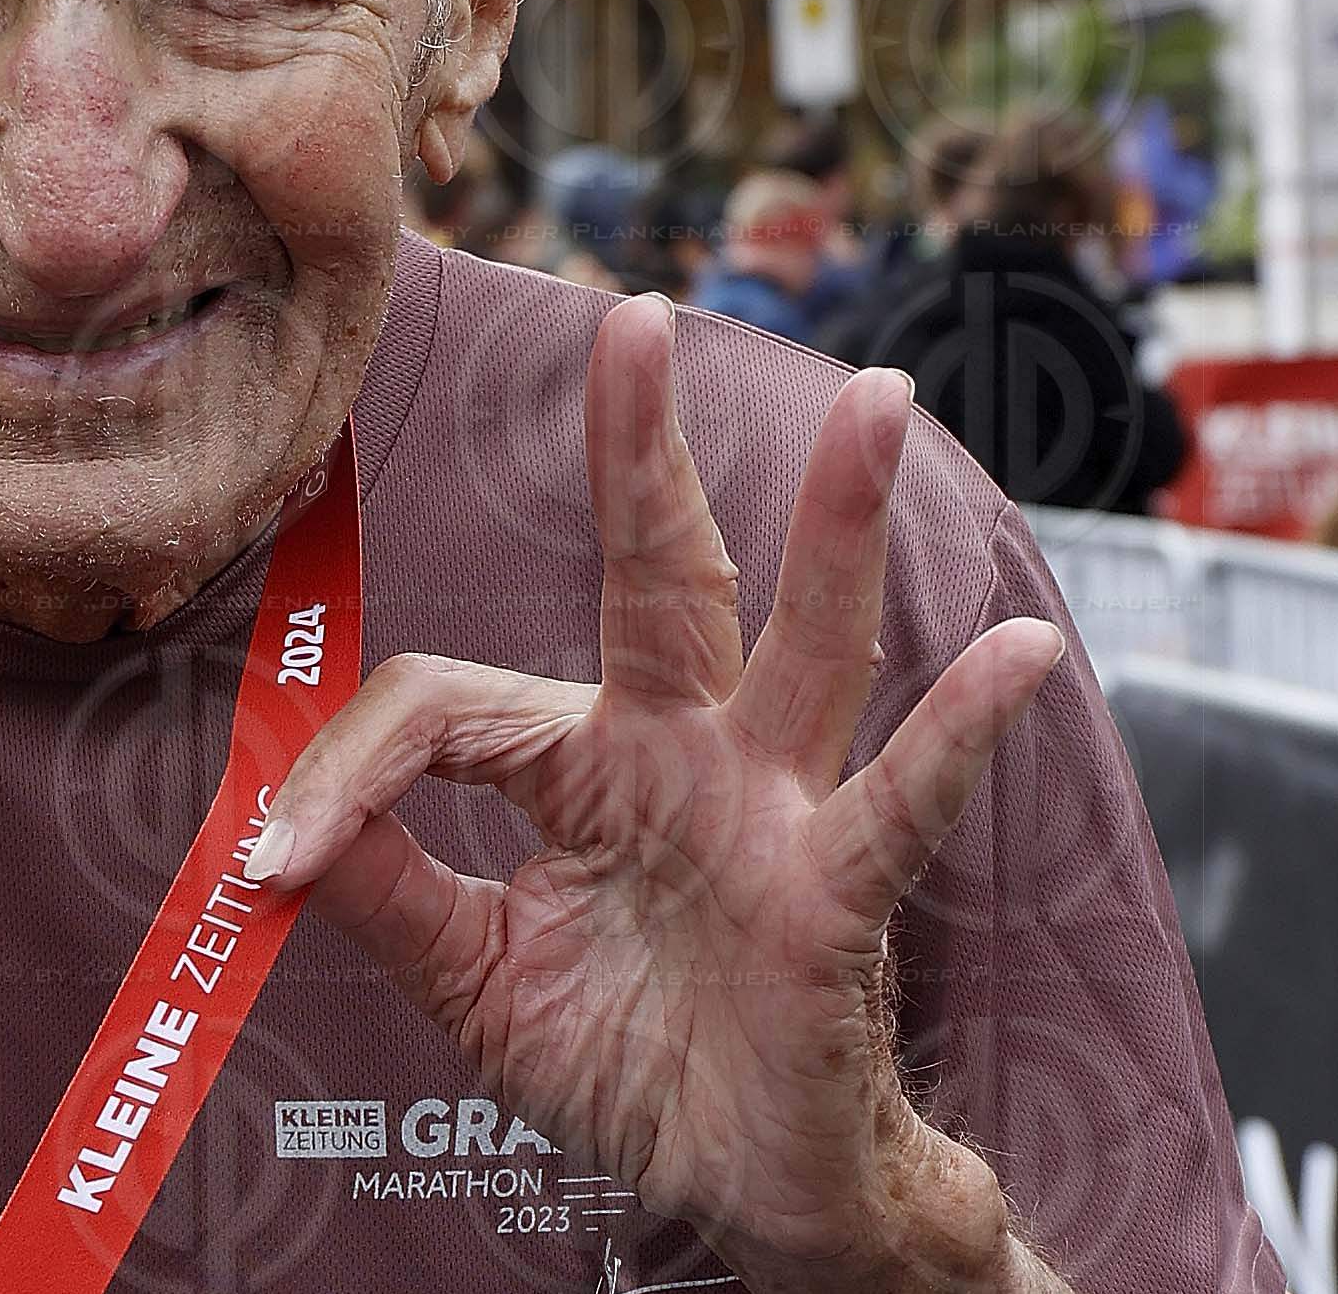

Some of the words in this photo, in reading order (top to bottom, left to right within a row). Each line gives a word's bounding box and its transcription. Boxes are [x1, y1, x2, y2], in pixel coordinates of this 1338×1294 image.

[277, 603, 326, 686] 2024
[57, 1000, 199, 1213] KLEINE
[281, 1109, 379, 1128] KLEINE
[282, 1130, 380, 1152] ZEITUNG
[401, 1098, 563, 1158] GRA
[352, 1169, 543, 1201] MARATHON
[496, 1206, 571, 1235] 2023
